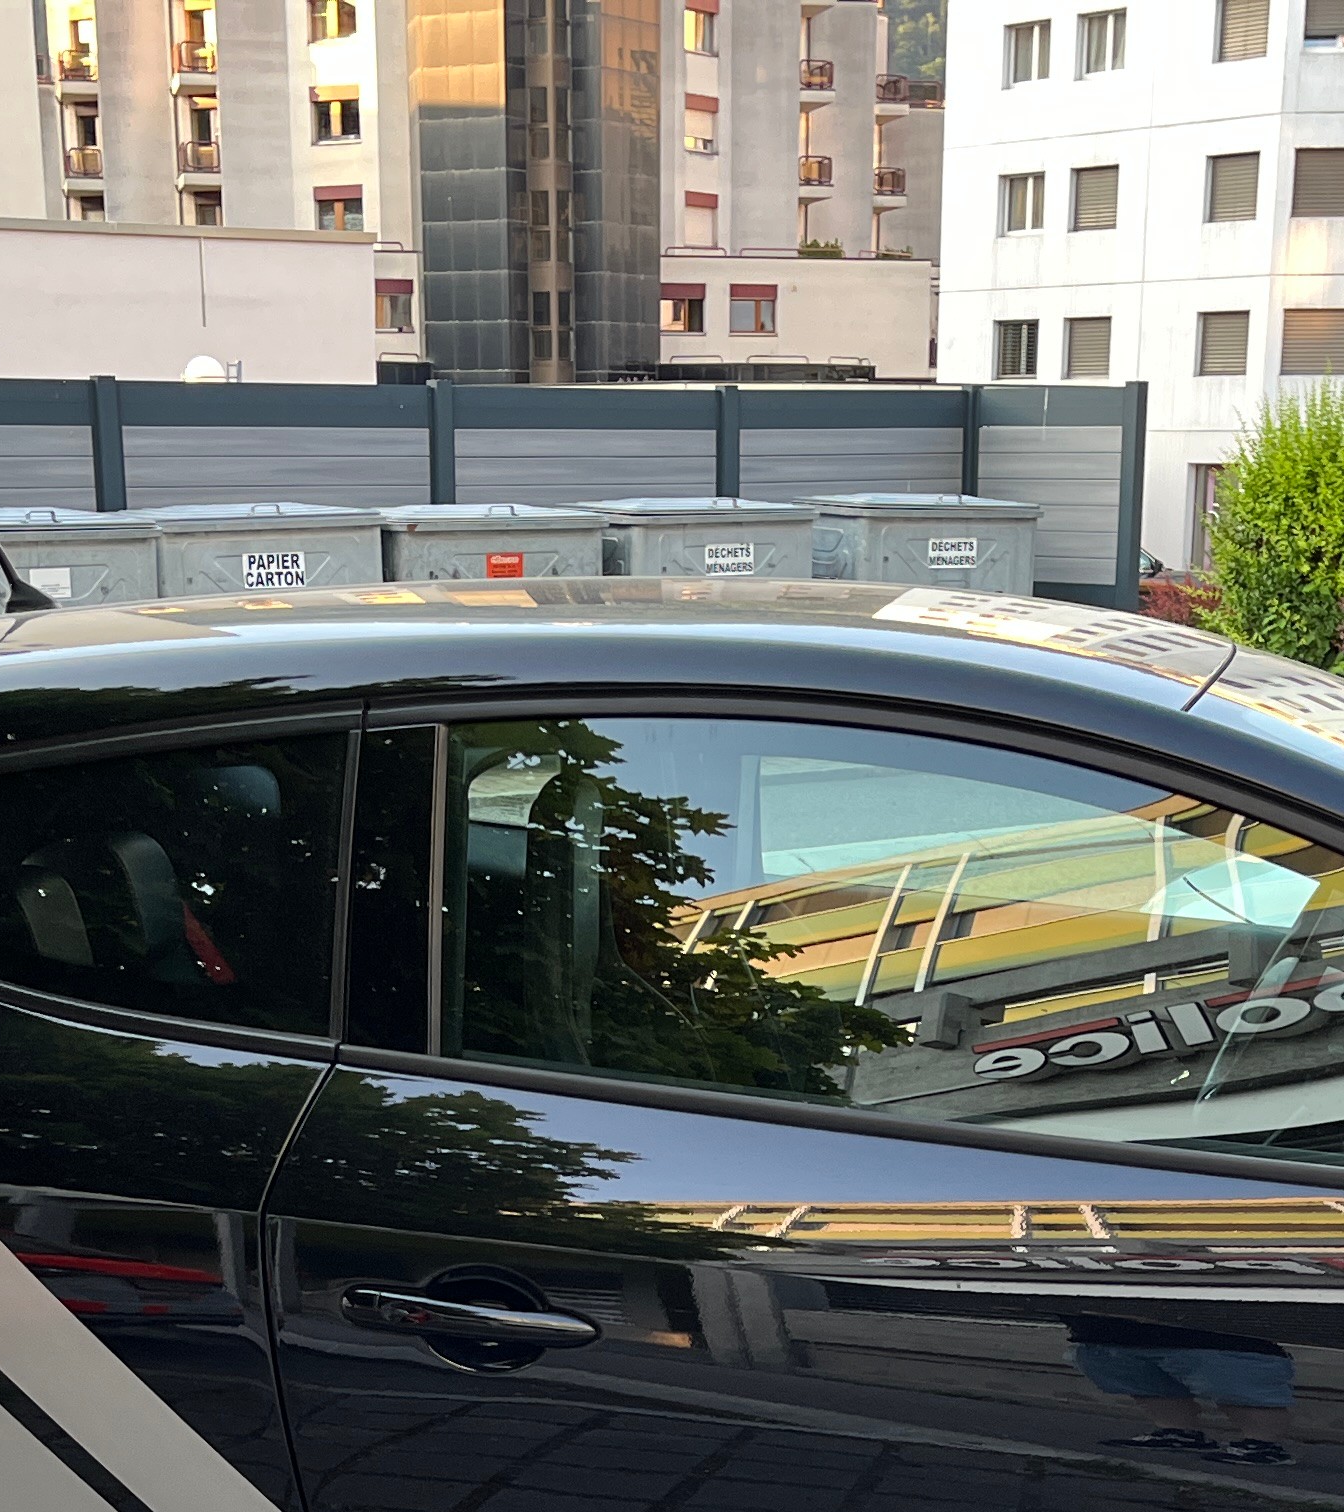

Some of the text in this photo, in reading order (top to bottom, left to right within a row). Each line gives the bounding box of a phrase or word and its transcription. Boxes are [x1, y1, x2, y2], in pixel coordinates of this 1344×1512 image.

[708, 545, 751, 558] DÉCHETS
[932, 540, 974, 551] DÉCHETS
[248, 554, 300, 570] PAPIER
[246, 571, 305, 587] CARTON
